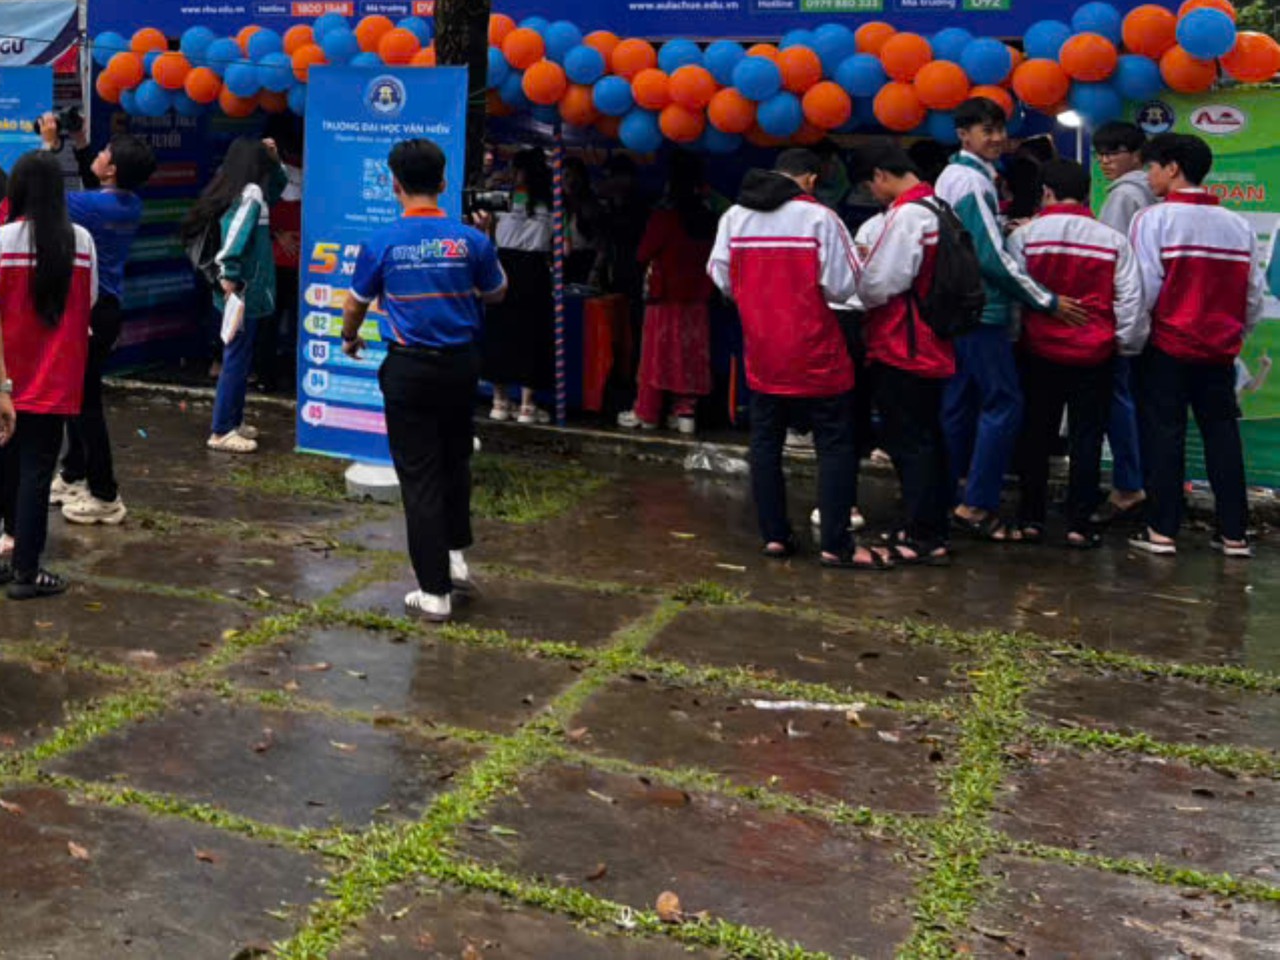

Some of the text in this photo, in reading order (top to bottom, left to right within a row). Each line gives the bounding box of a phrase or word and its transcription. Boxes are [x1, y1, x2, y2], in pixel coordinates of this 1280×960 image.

[1202, 184, 1266, 206] OẠN
[309, 242, 341, 274] 5
[314, 287, 328, 301] 01
[312, 316, 326, 330] 02
[312, 344, 326, 358] 03
[310, 373, 324, 387] 04
[308, 404, 323, 419] 05
